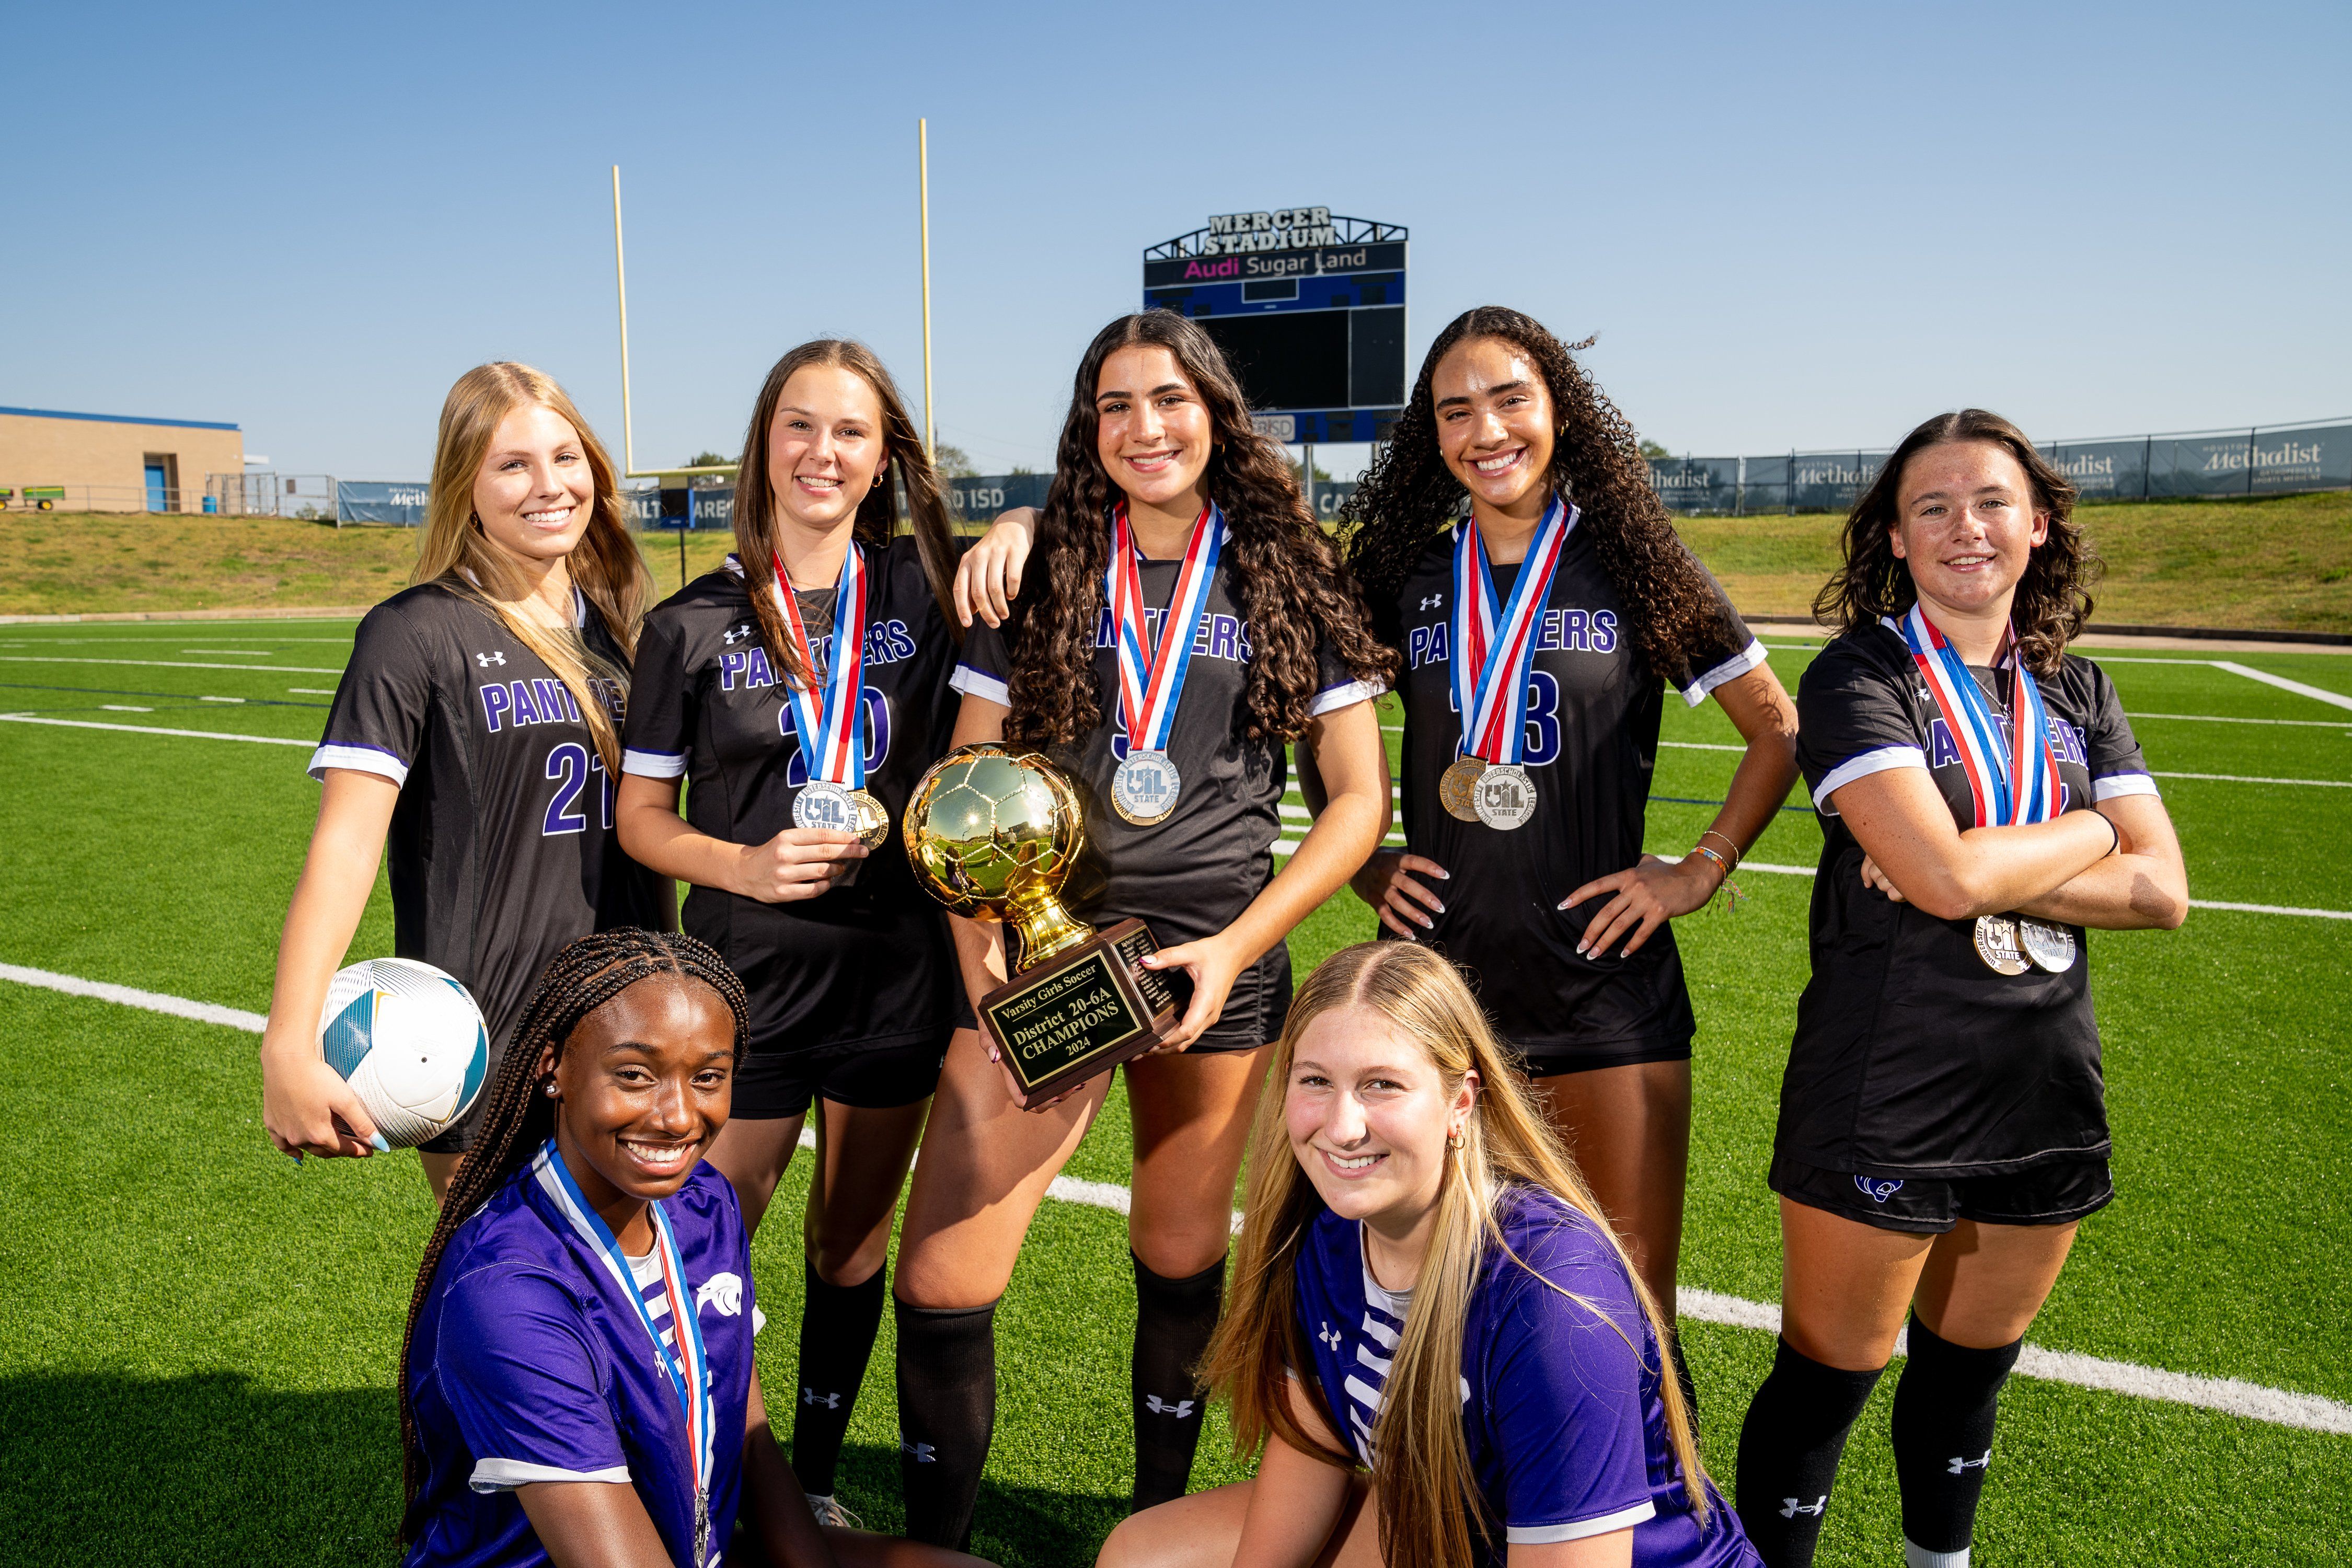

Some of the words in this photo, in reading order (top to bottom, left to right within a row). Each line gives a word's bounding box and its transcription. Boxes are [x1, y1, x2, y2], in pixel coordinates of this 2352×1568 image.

[1209, 206, 1331, 235] MERCER
[1204, 226, 1336, 256] STADIUM
[1183, 256, 1239, 279] Audi
[1247, 256, 1308, 276] Sugar
[1315, 248, 1366, 269] Land
[2203, 442, 2322, 470] Methodist
[970, 488, 1005, 509] ISD
[543, 742, 615, 836] 21
[1127, 766, 1167, 794] UIL
[1484, 779, 1525, 808] UIL
[805, 795, 845, 824] UIL
[1977, 925, 1996, 966] UNIVERSITY
[1994, 950, 2020, 960] STATE
[1001, 997, 1037, 1019] Varsity
[1037, 983, 1063, 1000] Girls
[1063, 964, 1097, 987] Soccer
[1012, 1011, 1065, 1046] District
[1068, 987, 1112, 1017] 20-6A
[1023, 1001, 1119, 1059] CHAMPIONS
[1066, 1036, 1091, 1056] 2024
